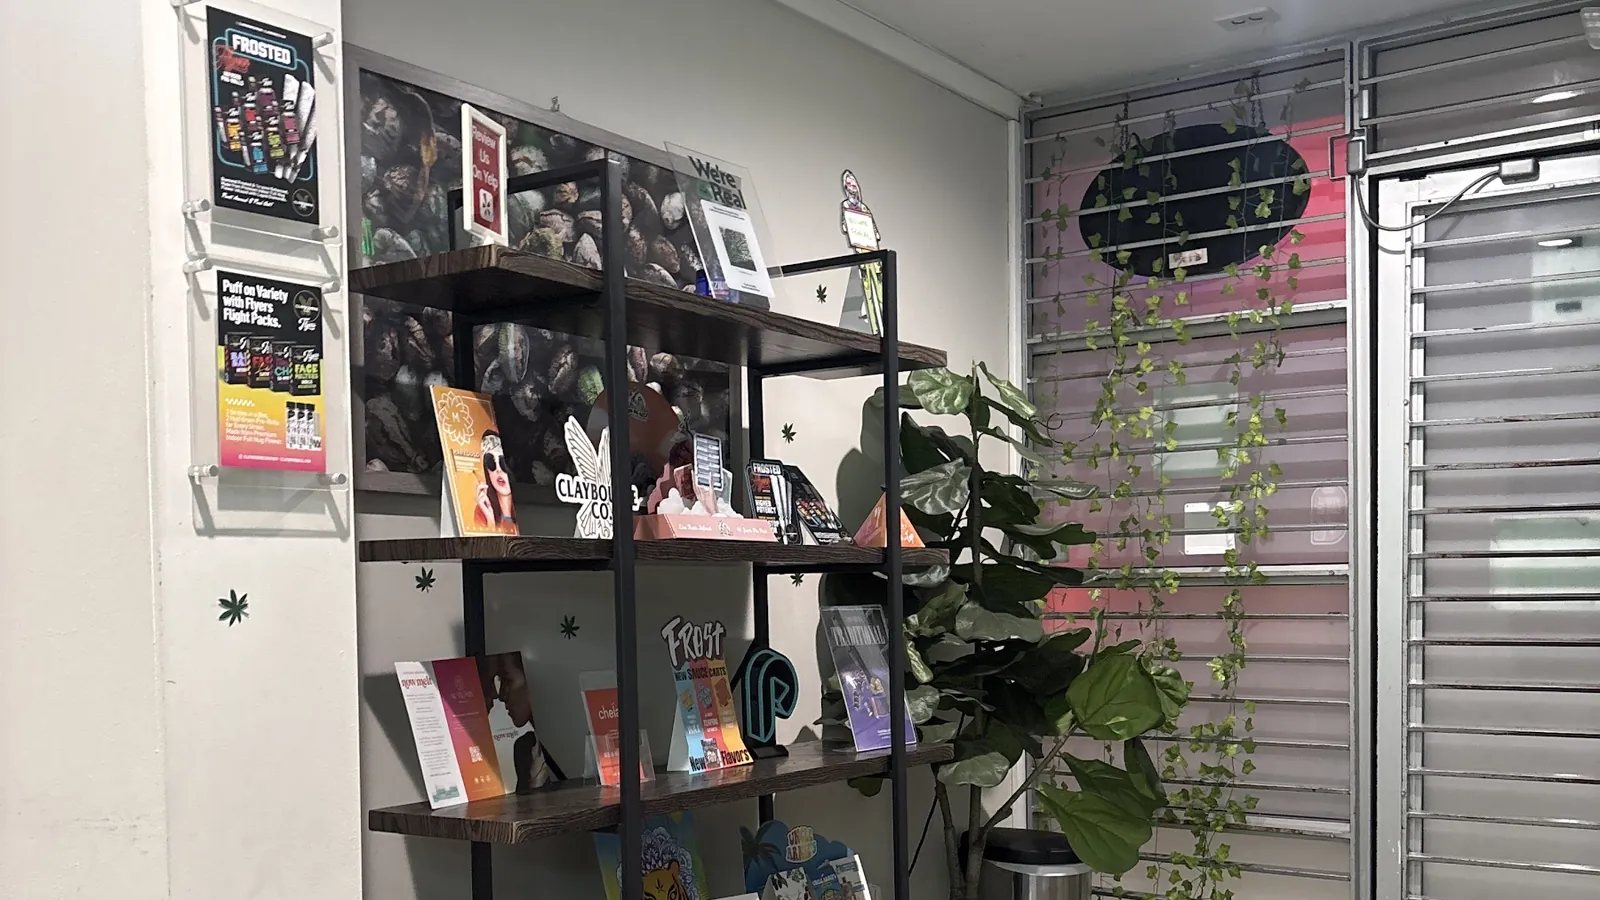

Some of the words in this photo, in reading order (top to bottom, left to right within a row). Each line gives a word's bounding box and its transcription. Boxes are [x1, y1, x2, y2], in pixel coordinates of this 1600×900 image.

[232, 34, 291, 65] FROSTED
[472, 125, 496, 149] Review
[479, 149, 490, 165] Us
[472, 164, 482, 181] On
[483, 171, 499, 191] Yelp
[688, 156, 736, 189] We're
[710, 182, 747, 210] Real
[222, 279, 243, 294] Puff
[243, 285, 256, 296] on
[256, 284, 289, 304] Variety
[222, 295, 244, 308] with
[245, 297, 274, 313] Flyers
[223, 307, 250, 325] Flight
[251, 311, 282, 328] Packs.
[294, 364, 319, 373] FACE
[752, 462, 781, 475] FROSTED
[687, 667, 709, 680] SAUCE
[709, 666, 727, 677] CARTS
[689, 755, 706, 772] New
[720, 749, 750, 765] Flavors
